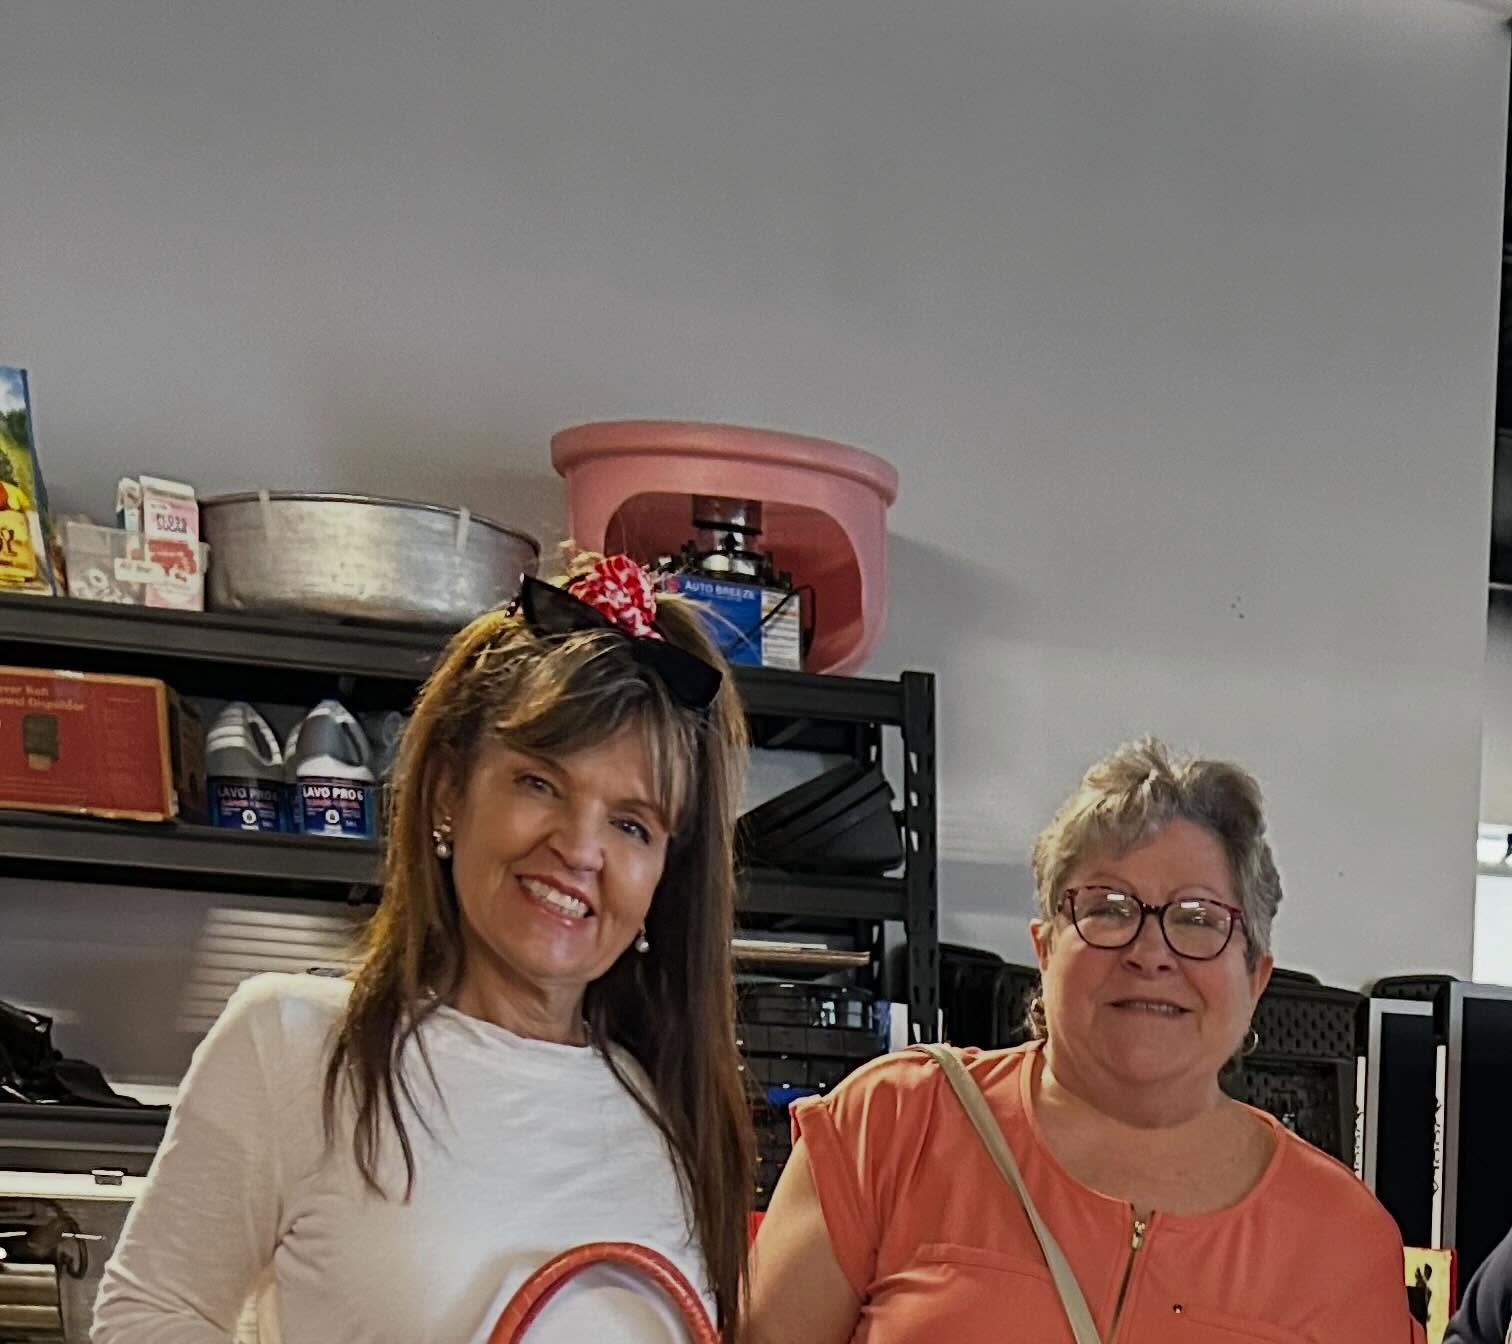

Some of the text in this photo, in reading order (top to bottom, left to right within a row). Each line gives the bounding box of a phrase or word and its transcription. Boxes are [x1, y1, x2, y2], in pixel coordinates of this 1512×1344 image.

[685, 580, 714, 593] AUTO
[303, 784, 331, 798] LAVO
[332, 788, 356, 800] PRO
